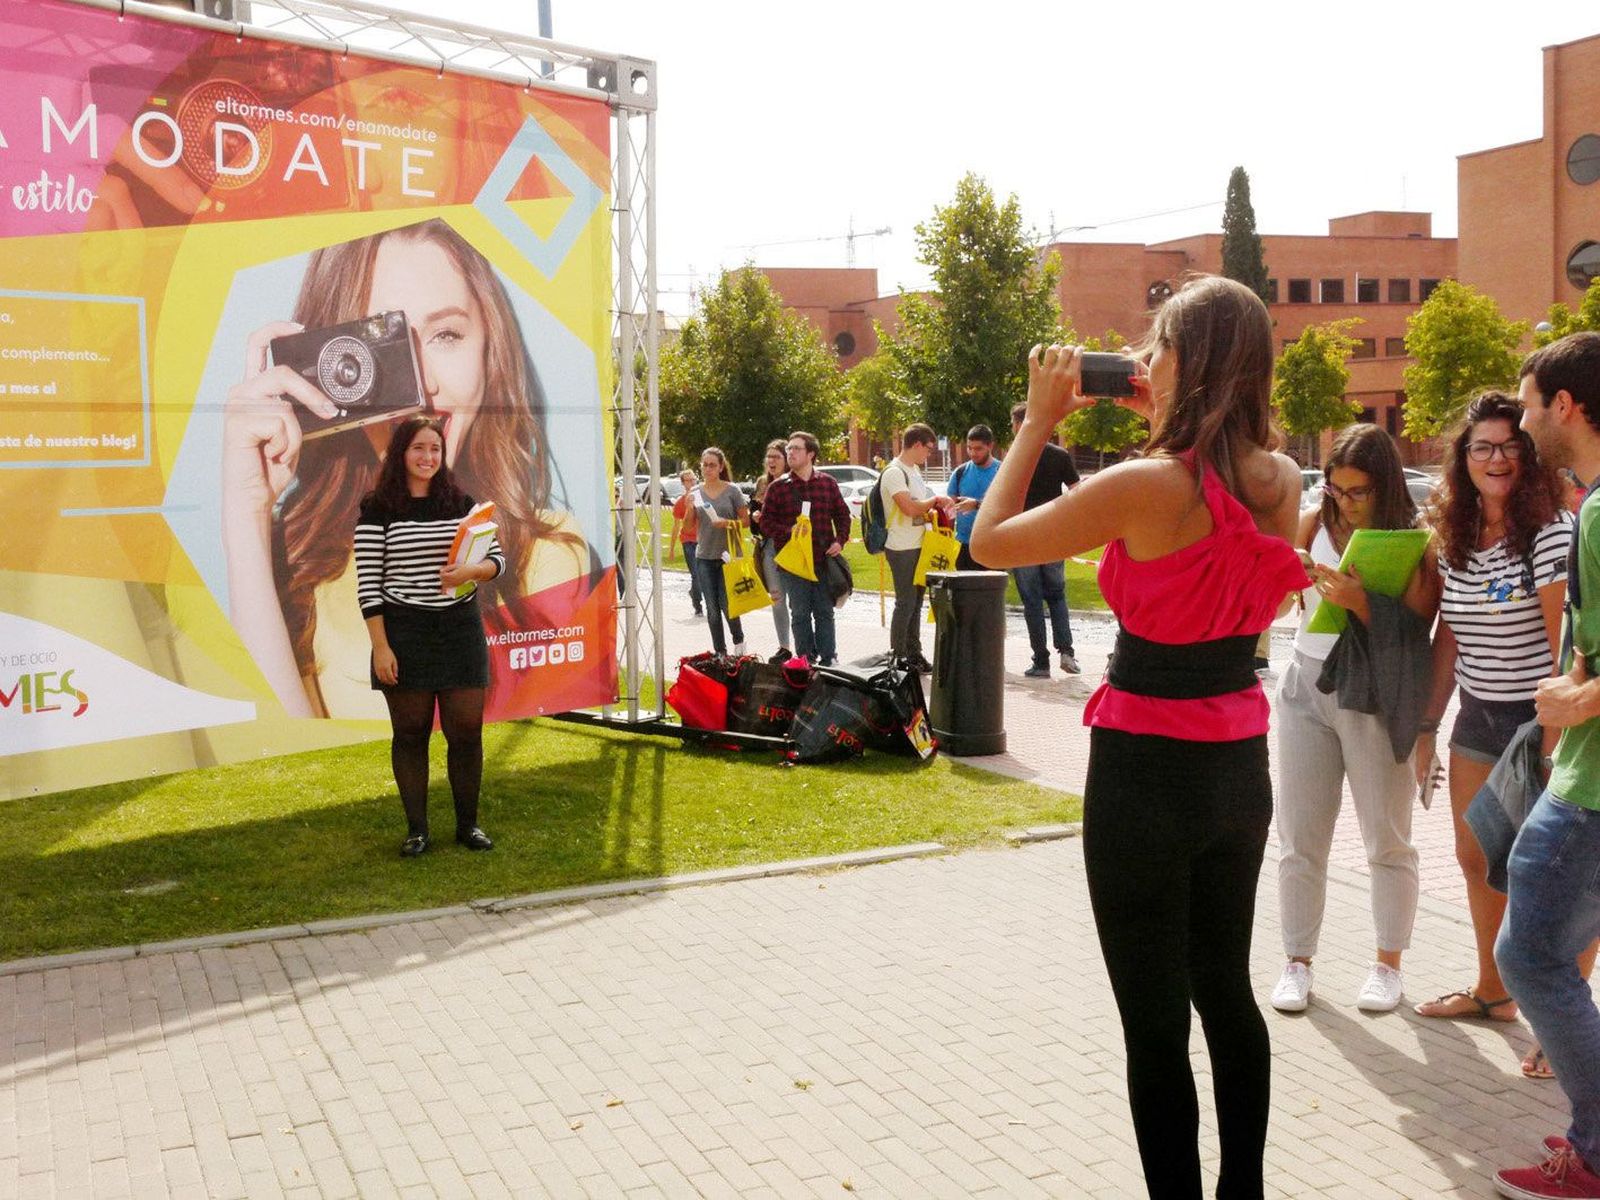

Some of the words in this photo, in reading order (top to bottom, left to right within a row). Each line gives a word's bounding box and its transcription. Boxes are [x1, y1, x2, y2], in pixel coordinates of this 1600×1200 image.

[215, 97, 437, 144] eltormes.com/enamodate
[12, 169, 97, 213] estilo
[10, 384, 39, 394] mes
[24, 434, 42, 447] de
[46, 436, 99, 447] nuestro
[102, 434, 137, 449] blog!
[11, 654, 27, 666] DE
[30, 651, 58, 665] OCIO
